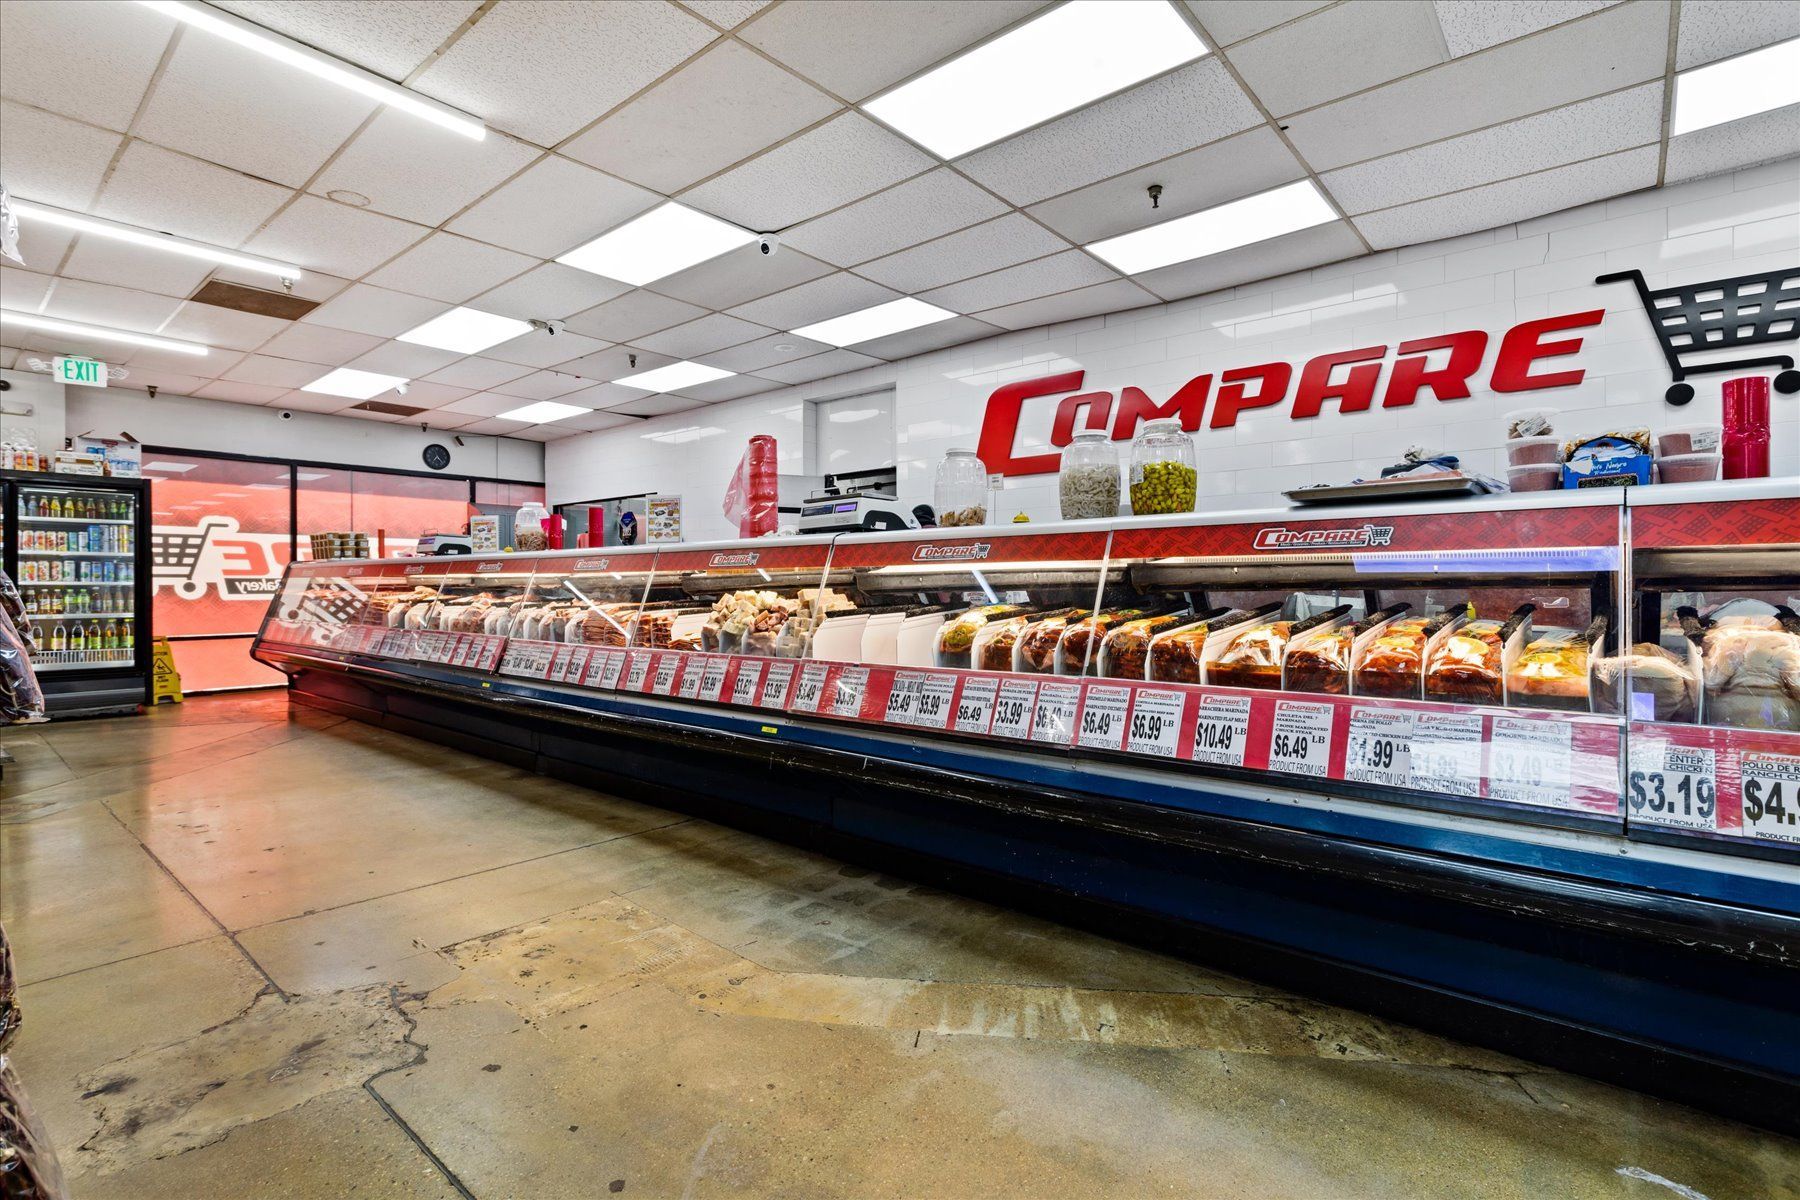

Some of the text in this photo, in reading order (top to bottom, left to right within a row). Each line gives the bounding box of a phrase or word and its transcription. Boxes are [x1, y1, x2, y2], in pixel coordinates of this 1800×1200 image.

[63, 359, 98, 382] EXIT
[976, 308, 1605, 477] COMPARE
[1254, 528, 1370, 548] COMPARE
[914, 545, 976, 560] COMPARE
[888, 693, 911, 712] $5.49
[919, 694, 940, 715] $5.99
[1278, 702, 1322, 712] COMPARE
[958, 705, 981, 721] $6.49
[995, 700, 1023, 725] $3.99
[1353, 709, 1401, 720] COMPARE
[1083, 711, 1122, 735] $6.49 LB
[1132, 713, 1161, 740] $6.99
[1196, 722, 1246, 750] $10.49 LB
[1274, 733, 1325, 759] $6.49 LB
[1396, 743, 1410, 753] LB
[1231, 753, 1241, 765] USA
[1669, 755, 1713, 766] ENTERO
[1742, 761, 1773, 770] POLLO
[1269, 760, 1326, 775] PRODUCT FROM USA
[1669, 763, 1713, 774] CHICKEN
[1742, 769, 1782, 779] RANCH
[1375, 771, 1392, 784] FROM
[1394, 773, 1406, 786] USA
[1488, 787, 1525, 800] PRODUCT
[1527, 791, 1549, 804] FROM
[1629, 769, 1715, 819] $3.19
[1744, 777, 1800, 827] $4.
[1669, 818, 1694, 827] FROM
[1696, 821, 1713, 829] USA
[1756, 831, 1790, 841] PRODUCT
